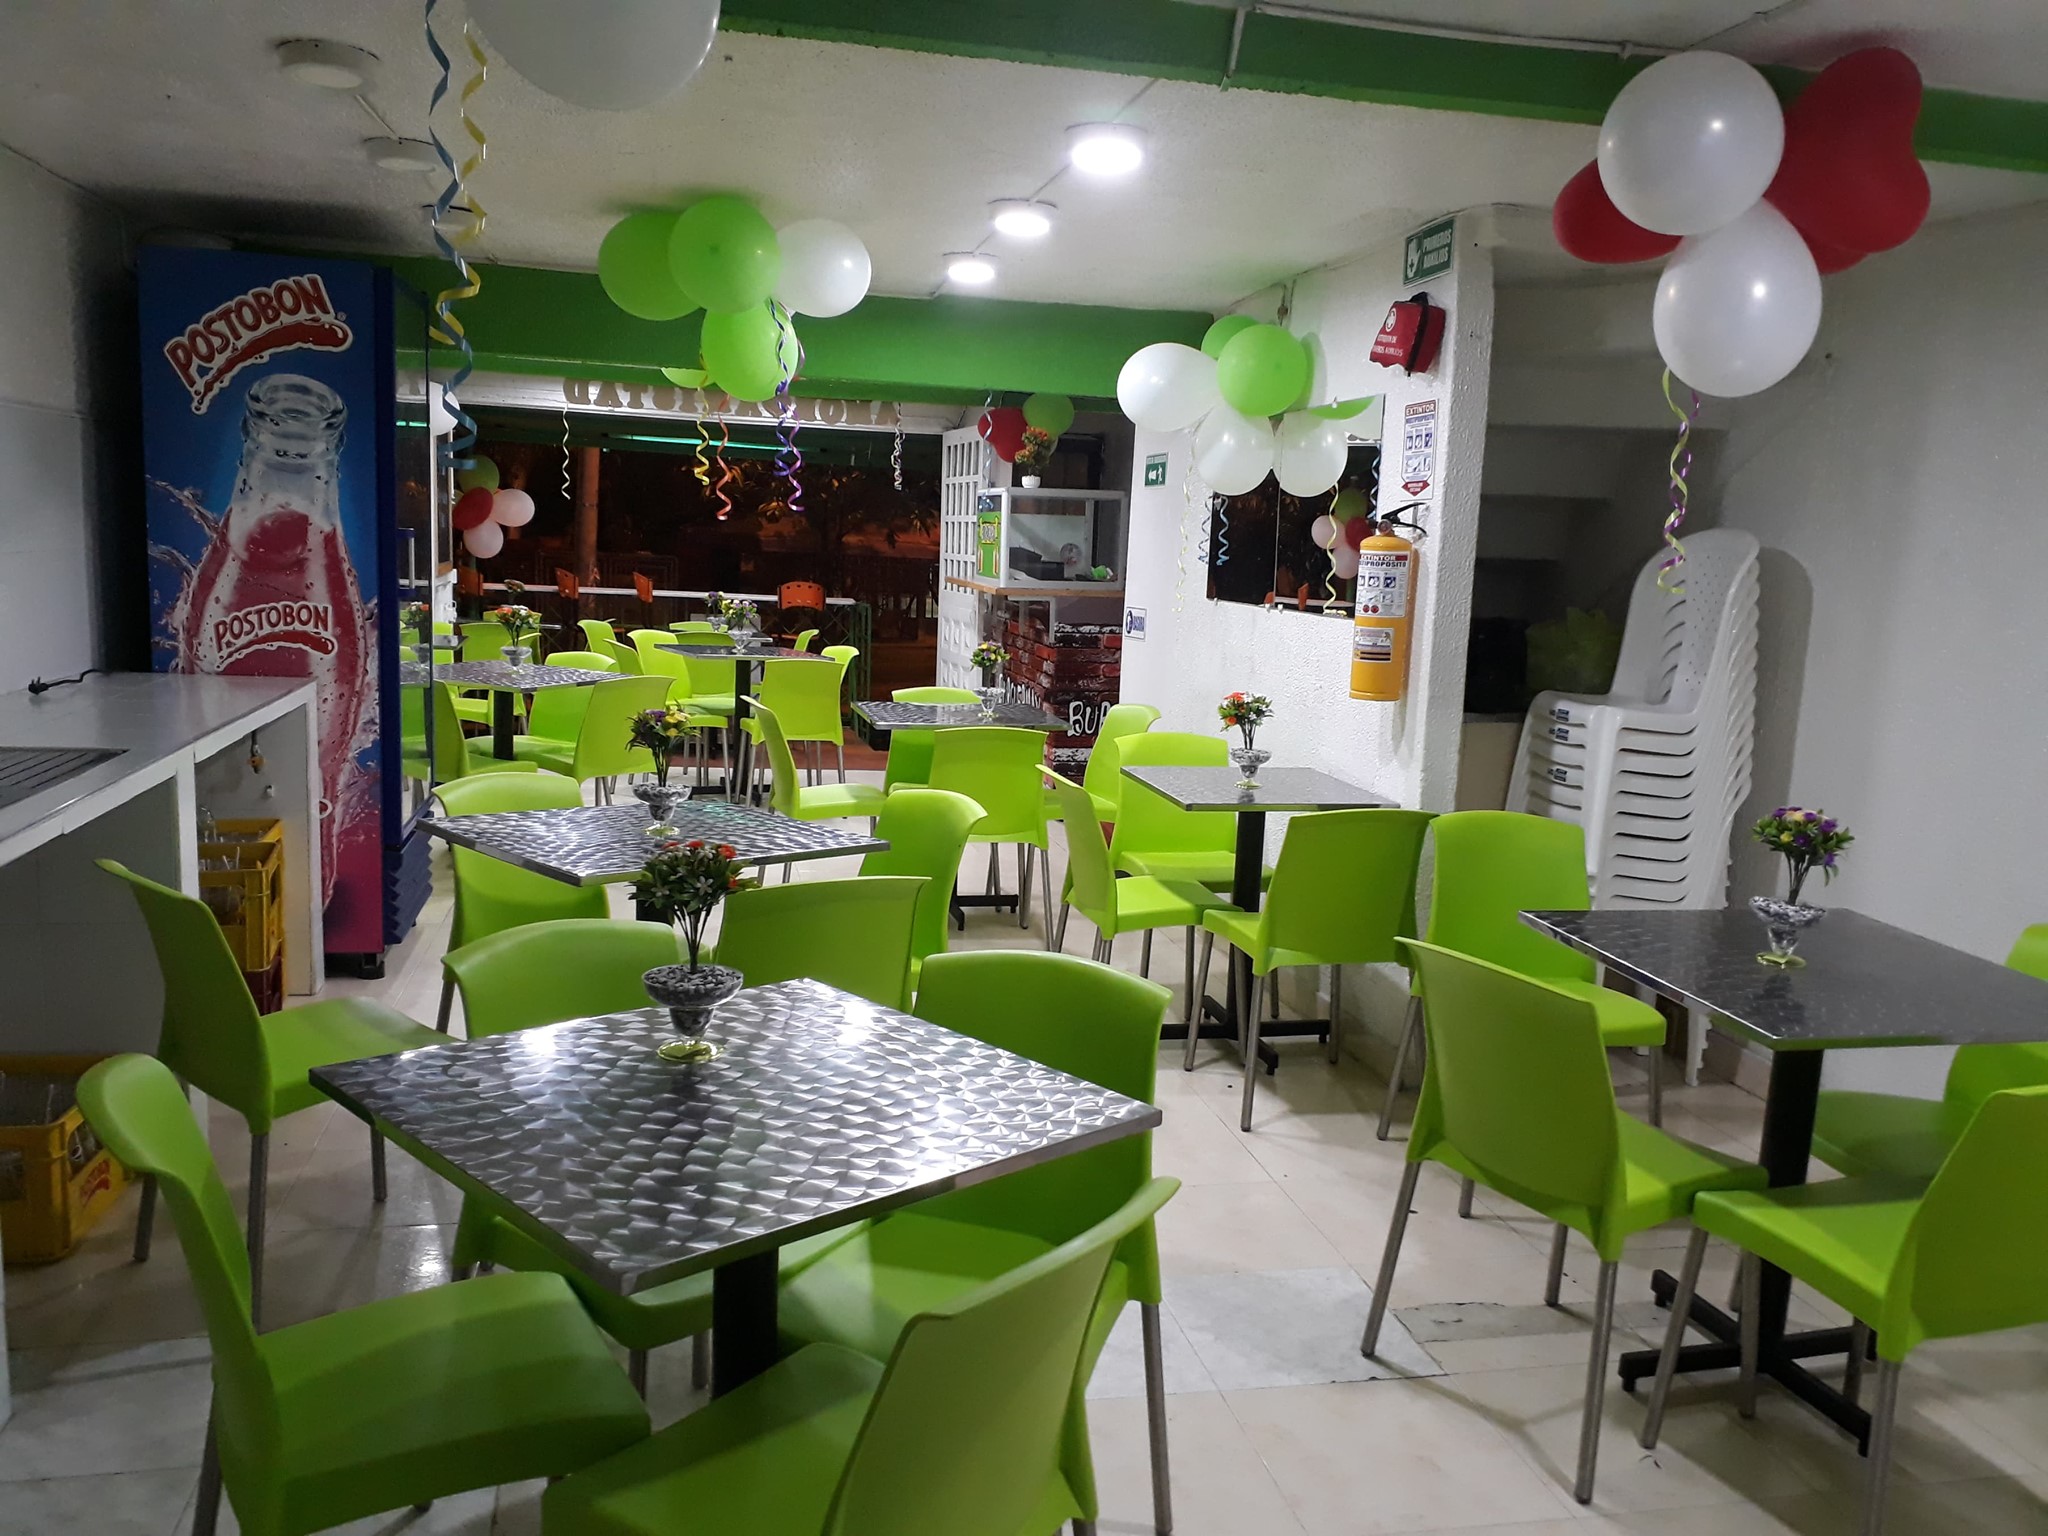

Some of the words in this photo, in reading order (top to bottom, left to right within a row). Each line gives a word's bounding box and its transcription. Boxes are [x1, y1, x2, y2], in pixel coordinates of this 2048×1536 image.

[1423, 229, 1452, 253] PRIMEROS
[1423, 247, 1449, 269] AUXILIOS
[166, 275, 331, 389] POSTOBON
[1405, 403, 1435, 415] EXTINTOR
[213, 603, 329, 653] POSTOBON
